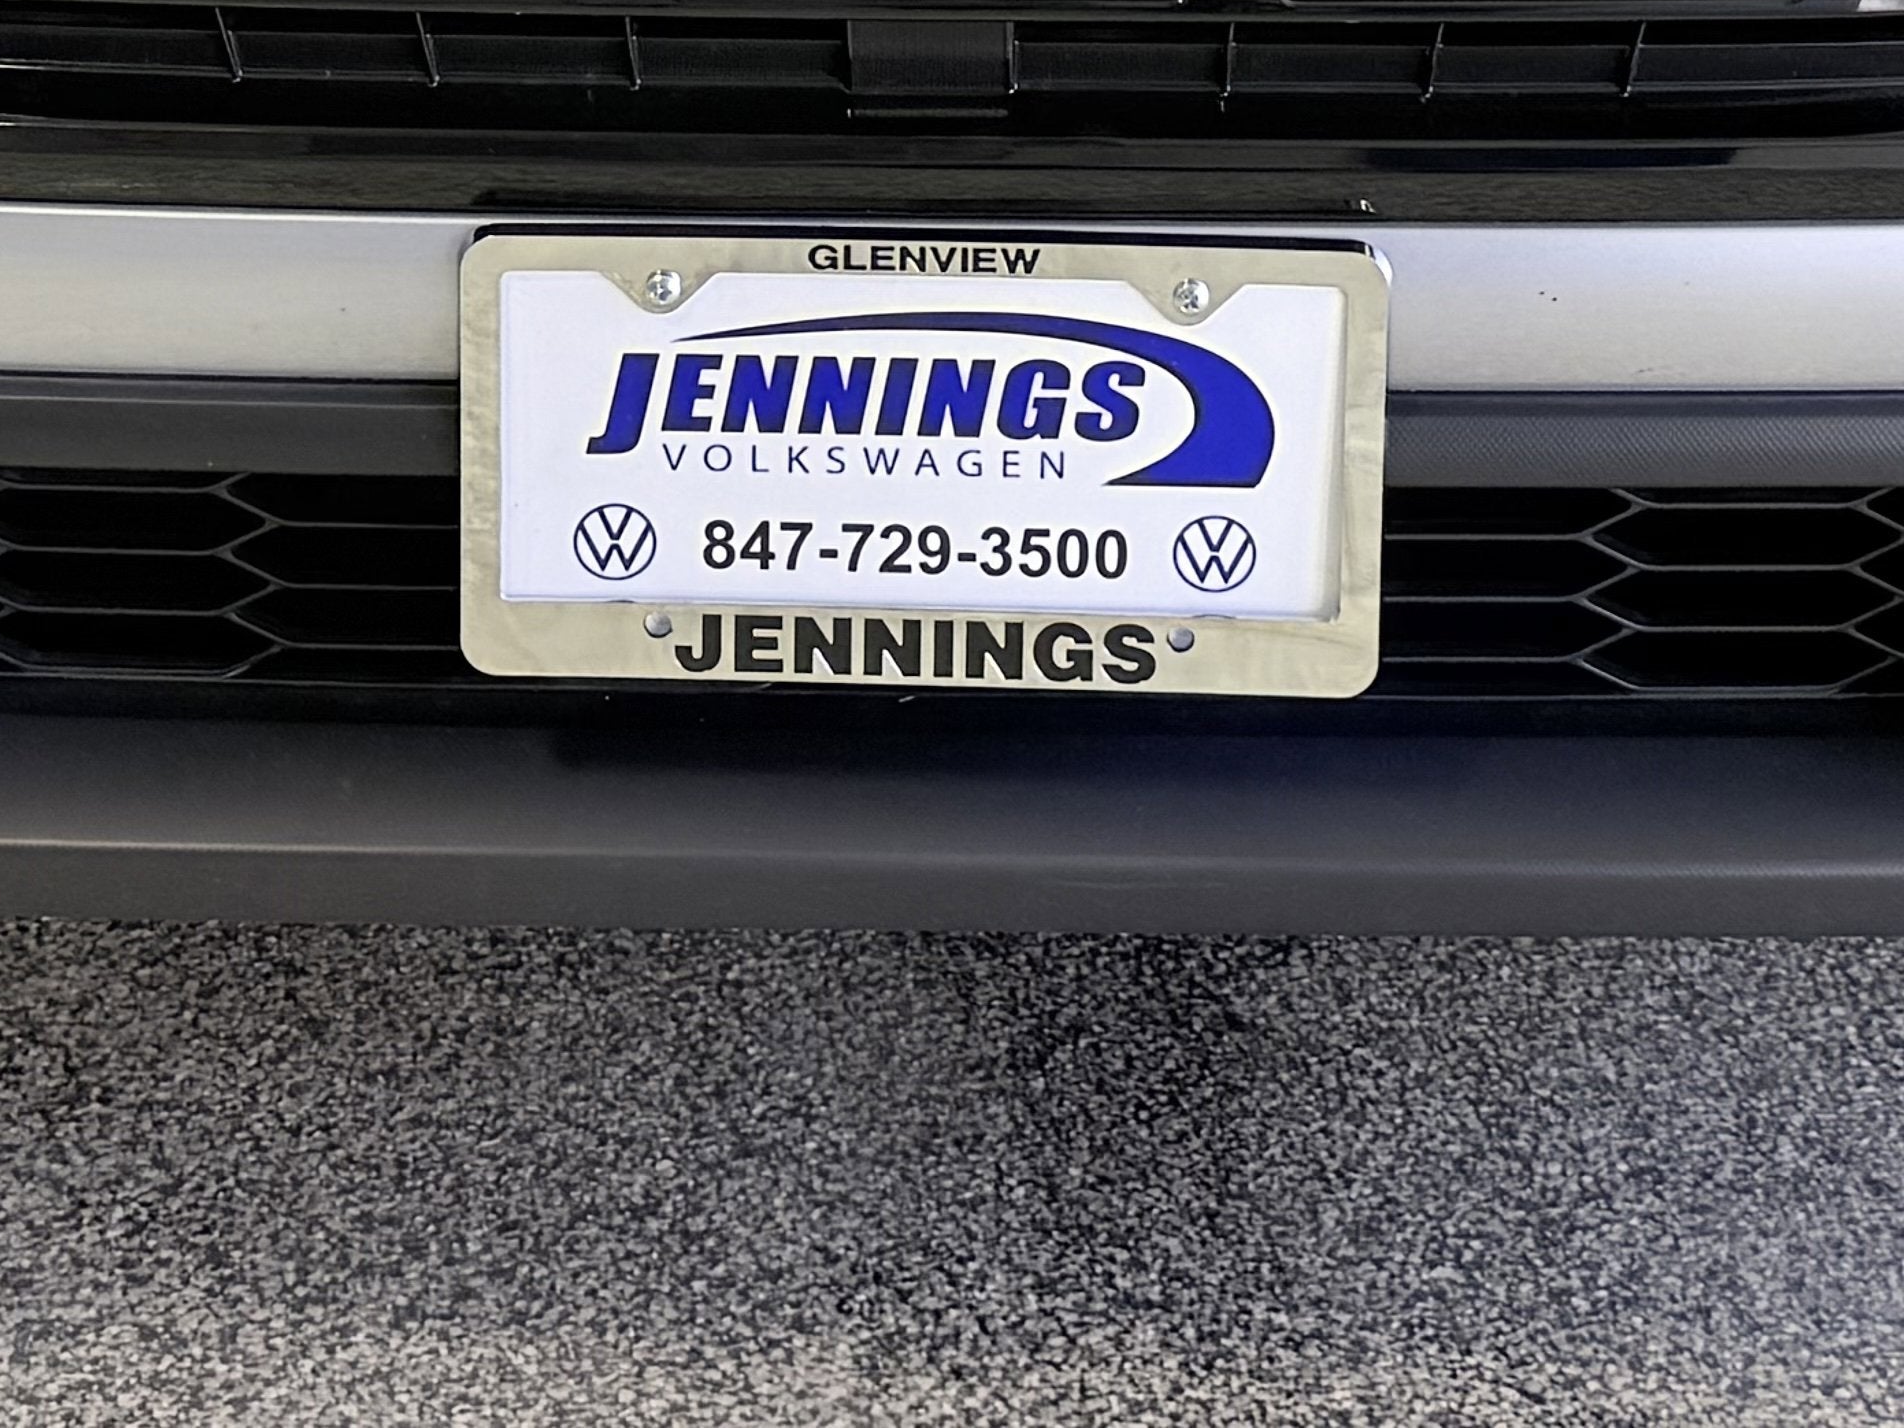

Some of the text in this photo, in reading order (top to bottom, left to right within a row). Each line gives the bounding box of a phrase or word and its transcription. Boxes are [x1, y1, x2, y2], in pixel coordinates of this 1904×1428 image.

[807, 244, 1041, 275] GLENVIEW
[585, 352, 1145, 454] JENNINGS
[662, 443, 1065, 479] VOLKSWAGEN
[703, 519, 1128, 579] 847-729-3500
[674, 613, 1157, 684] JENNINGS
